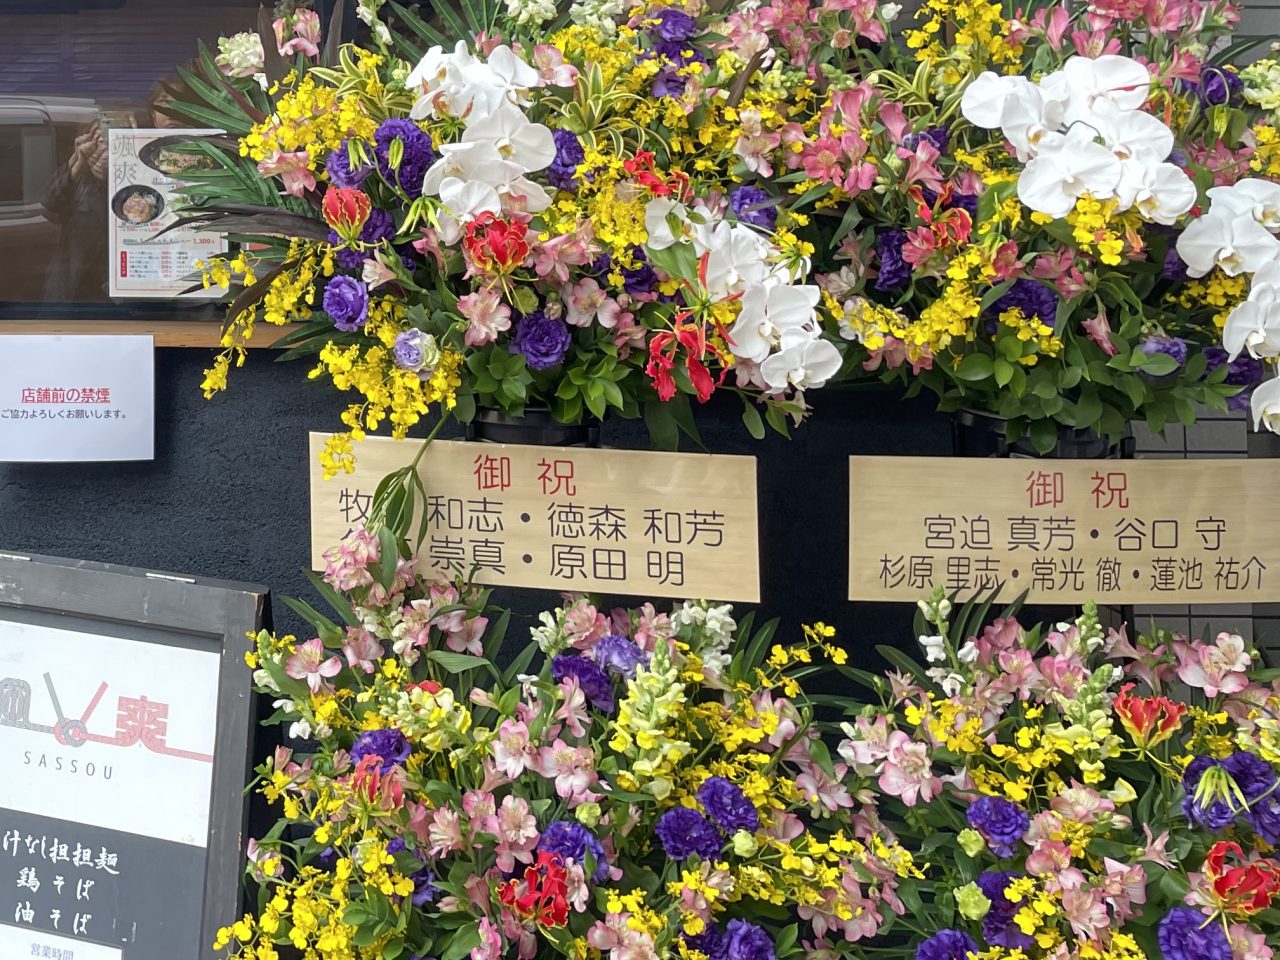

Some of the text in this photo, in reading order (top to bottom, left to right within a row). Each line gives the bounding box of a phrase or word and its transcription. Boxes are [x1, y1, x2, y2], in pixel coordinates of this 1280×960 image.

[21, 387, 111, 403] 店舗前の禁煙
[1, 409, 127, 420] ご協力よろしくお願いします。
[23, 751, 113, 780] SASSOU
[3, 829, 120, 875] 汁なし担担麺
